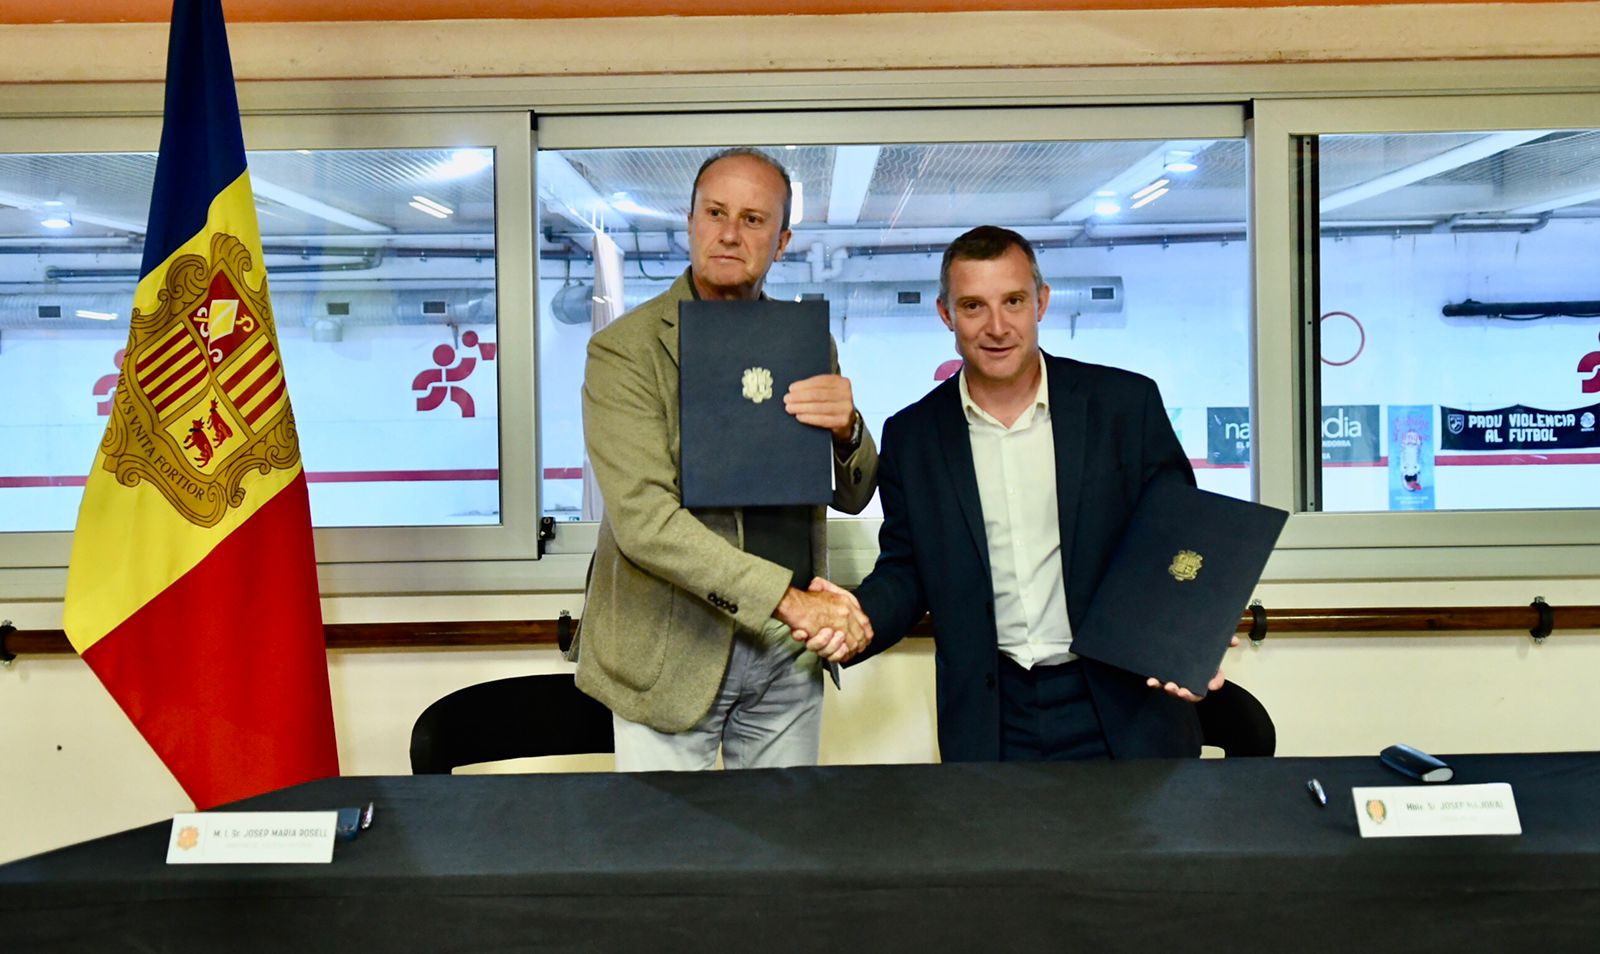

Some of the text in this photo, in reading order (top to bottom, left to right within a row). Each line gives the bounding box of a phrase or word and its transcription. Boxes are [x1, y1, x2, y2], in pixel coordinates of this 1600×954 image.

[1485, 428, 1558, 443] AL FUTBOL
[129, 415, 156, 457] VNITA
[153, 455, 205, 501] FORTIOR
[243, 829, 270, 838] JOSEP
[271, 829, 297, 838] MARIA
[299, 829, 328, 838] ROSELL
